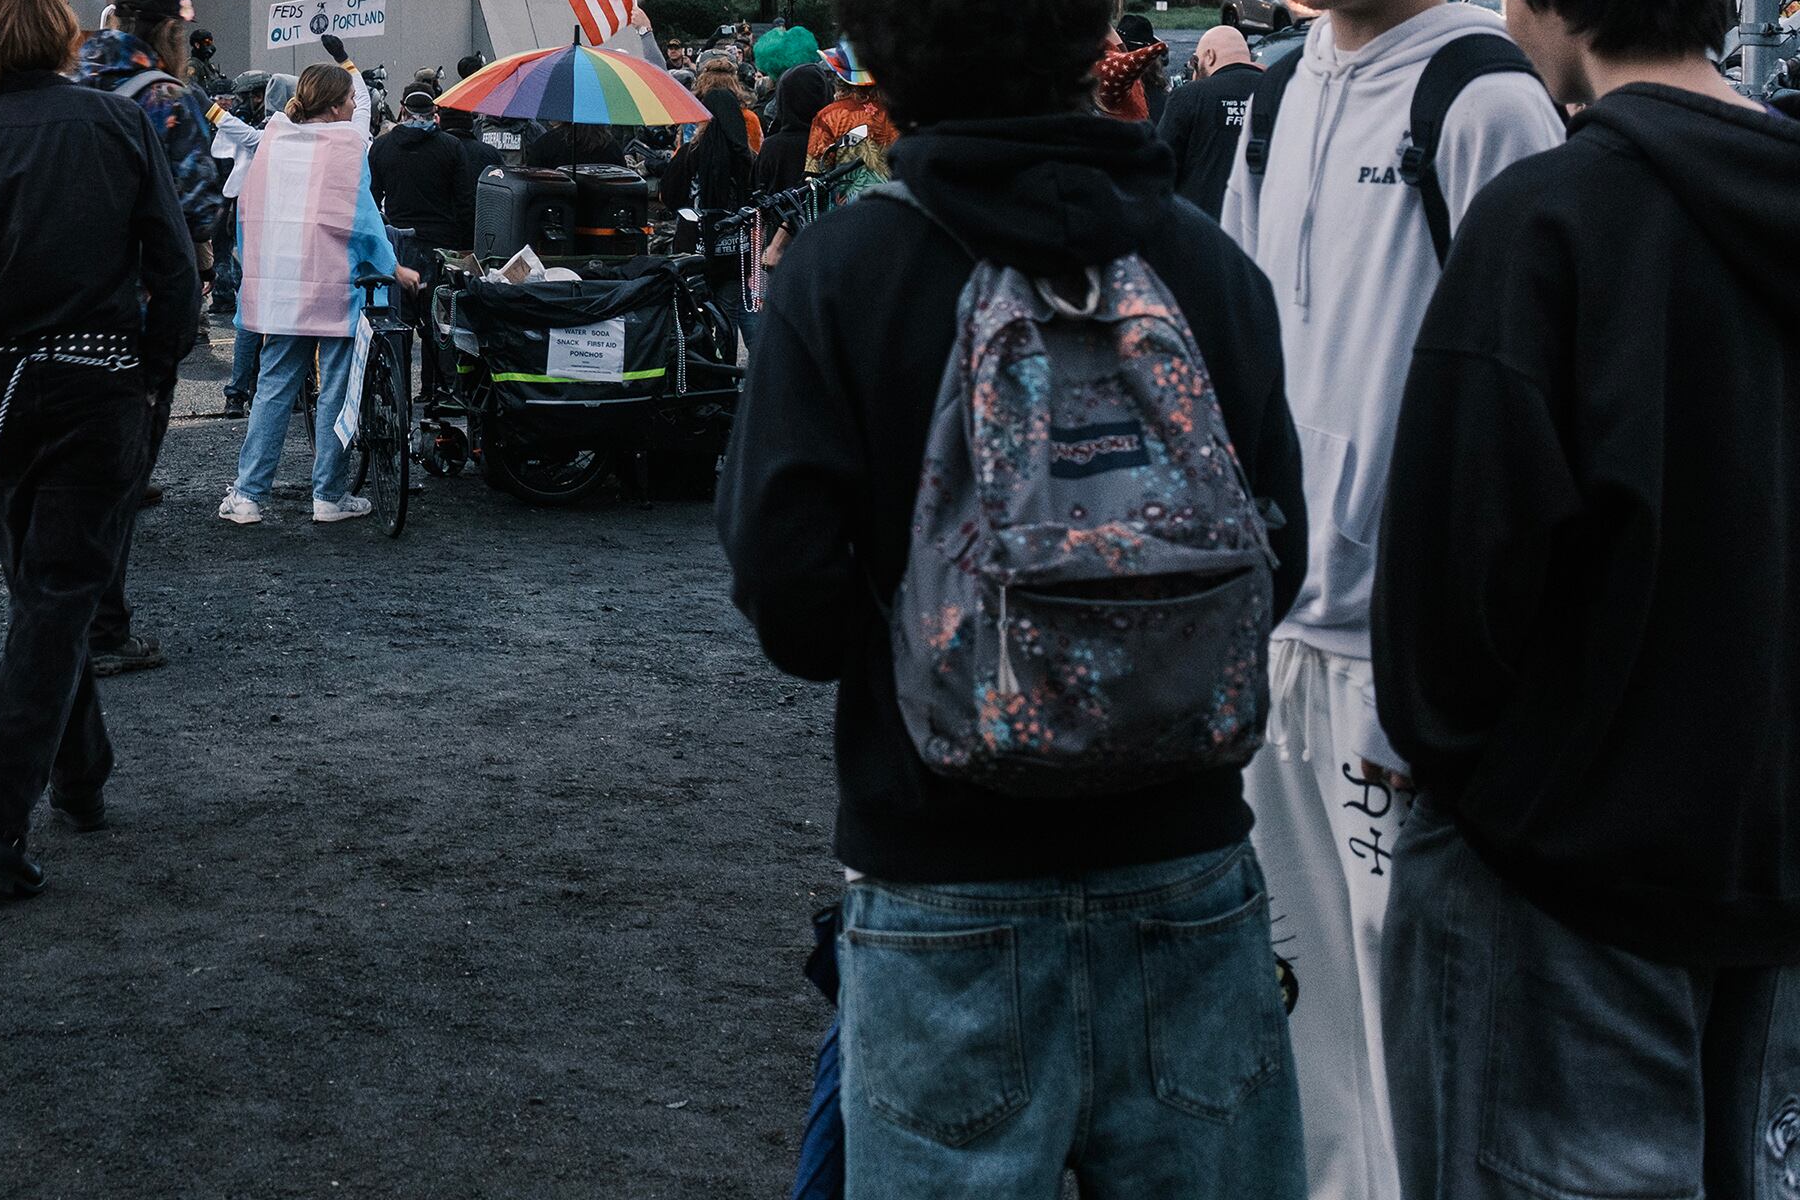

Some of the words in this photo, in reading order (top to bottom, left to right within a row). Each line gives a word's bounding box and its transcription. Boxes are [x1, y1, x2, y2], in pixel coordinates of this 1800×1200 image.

[272, 5, 304, 18] FEDS
[332, 10, 385, 31] PORTLAND
[271, 25, 302, 42] OUT
[1358, 166, 1401, 184] PLA
[587, 340, 605, 348] FIRST
[570, 351, 603, 359] PONCHOS
